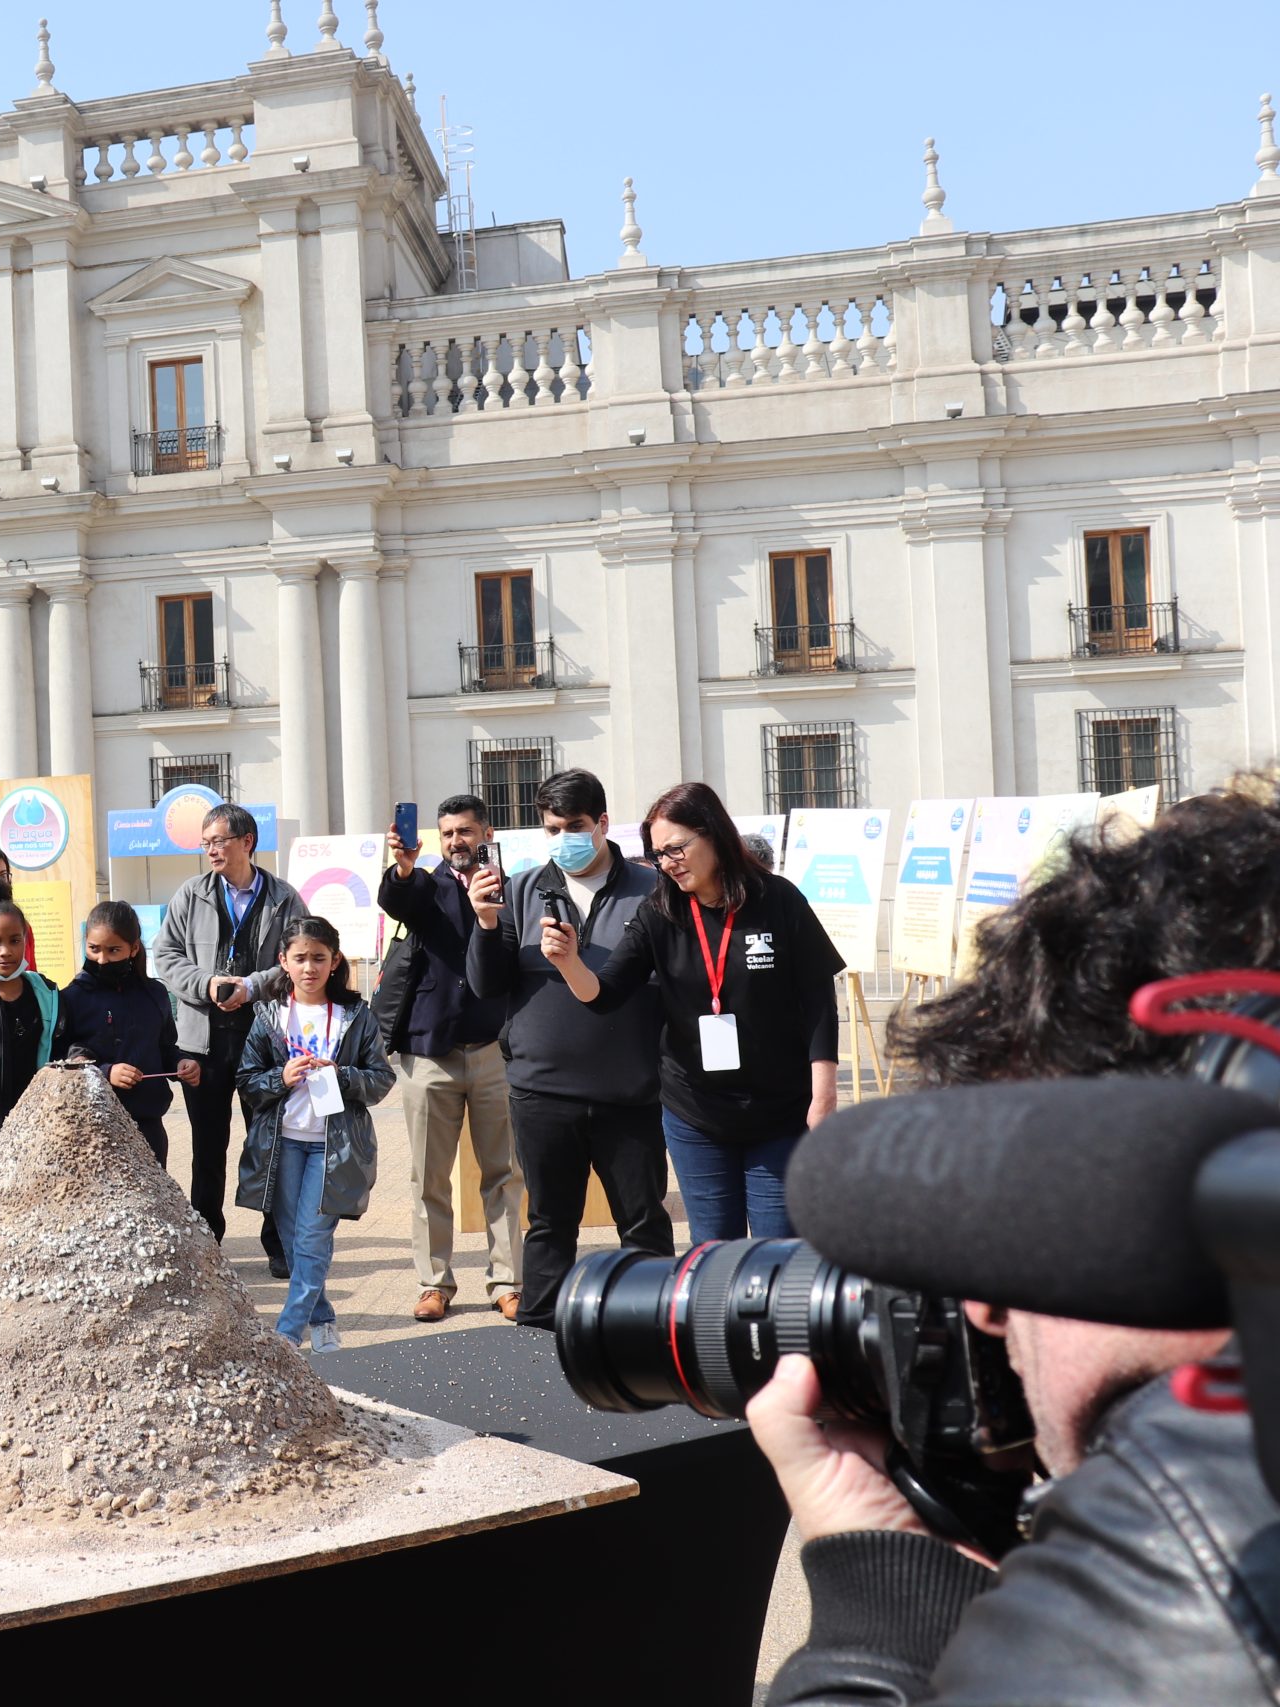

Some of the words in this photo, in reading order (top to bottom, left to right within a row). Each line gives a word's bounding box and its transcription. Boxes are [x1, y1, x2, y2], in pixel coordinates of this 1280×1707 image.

[8, 828, 19, 840] El
[22, 830, 53, 842] agua
[297, 843, 332, 858] 65%
[746, 955, 775, 964] Ckelar
[750, 1322, 761, 1361] Canon
